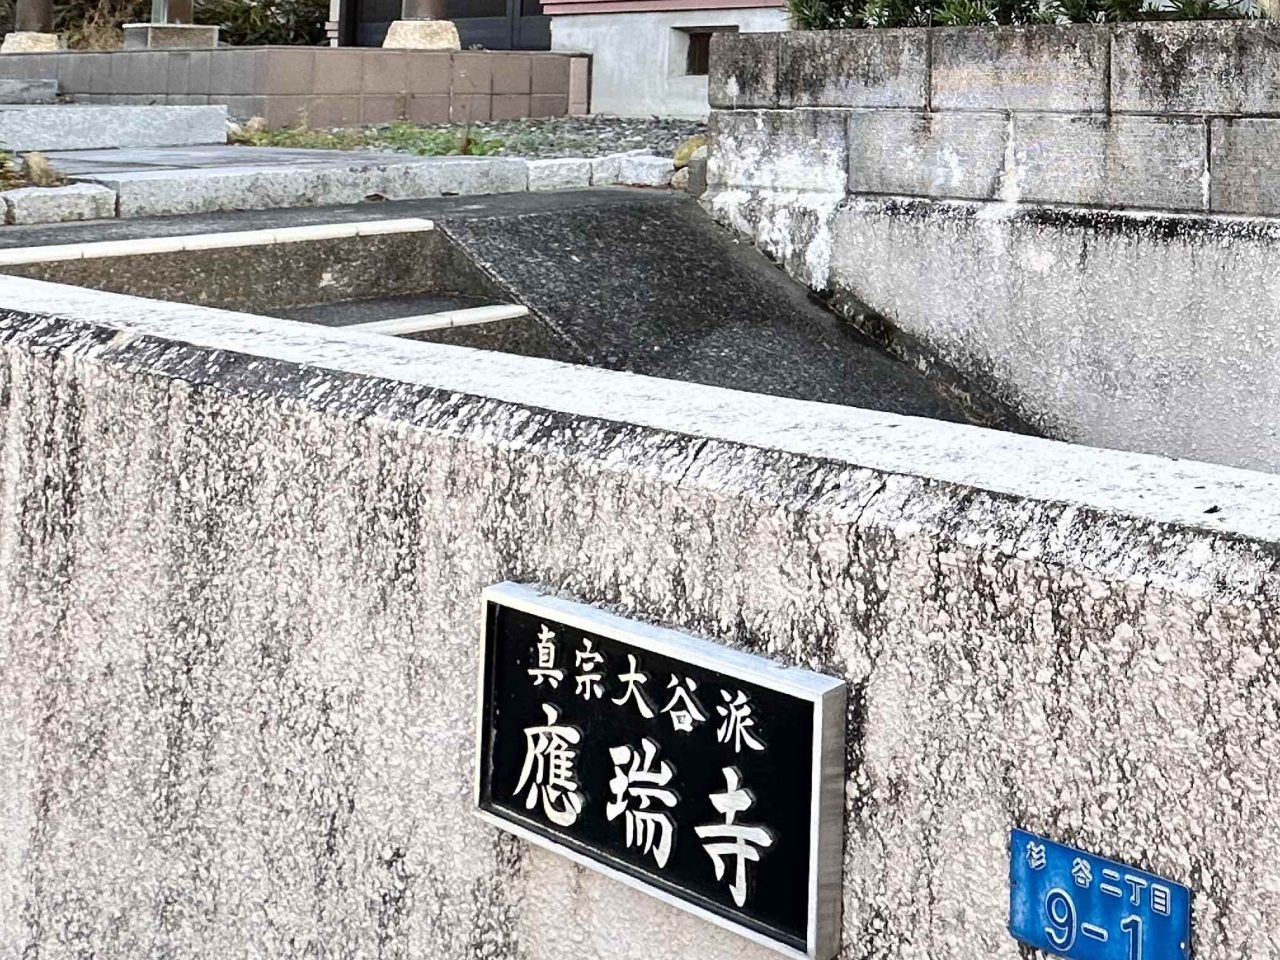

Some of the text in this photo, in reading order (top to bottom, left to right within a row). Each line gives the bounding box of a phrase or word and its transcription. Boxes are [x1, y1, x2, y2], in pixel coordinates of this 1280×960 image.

[527, 624, 766, 753] 真宗大谷派
[513, 704, 773, 907] 應瑞寺
[1026, 841, 1170, 916] 杉谷二丁目
